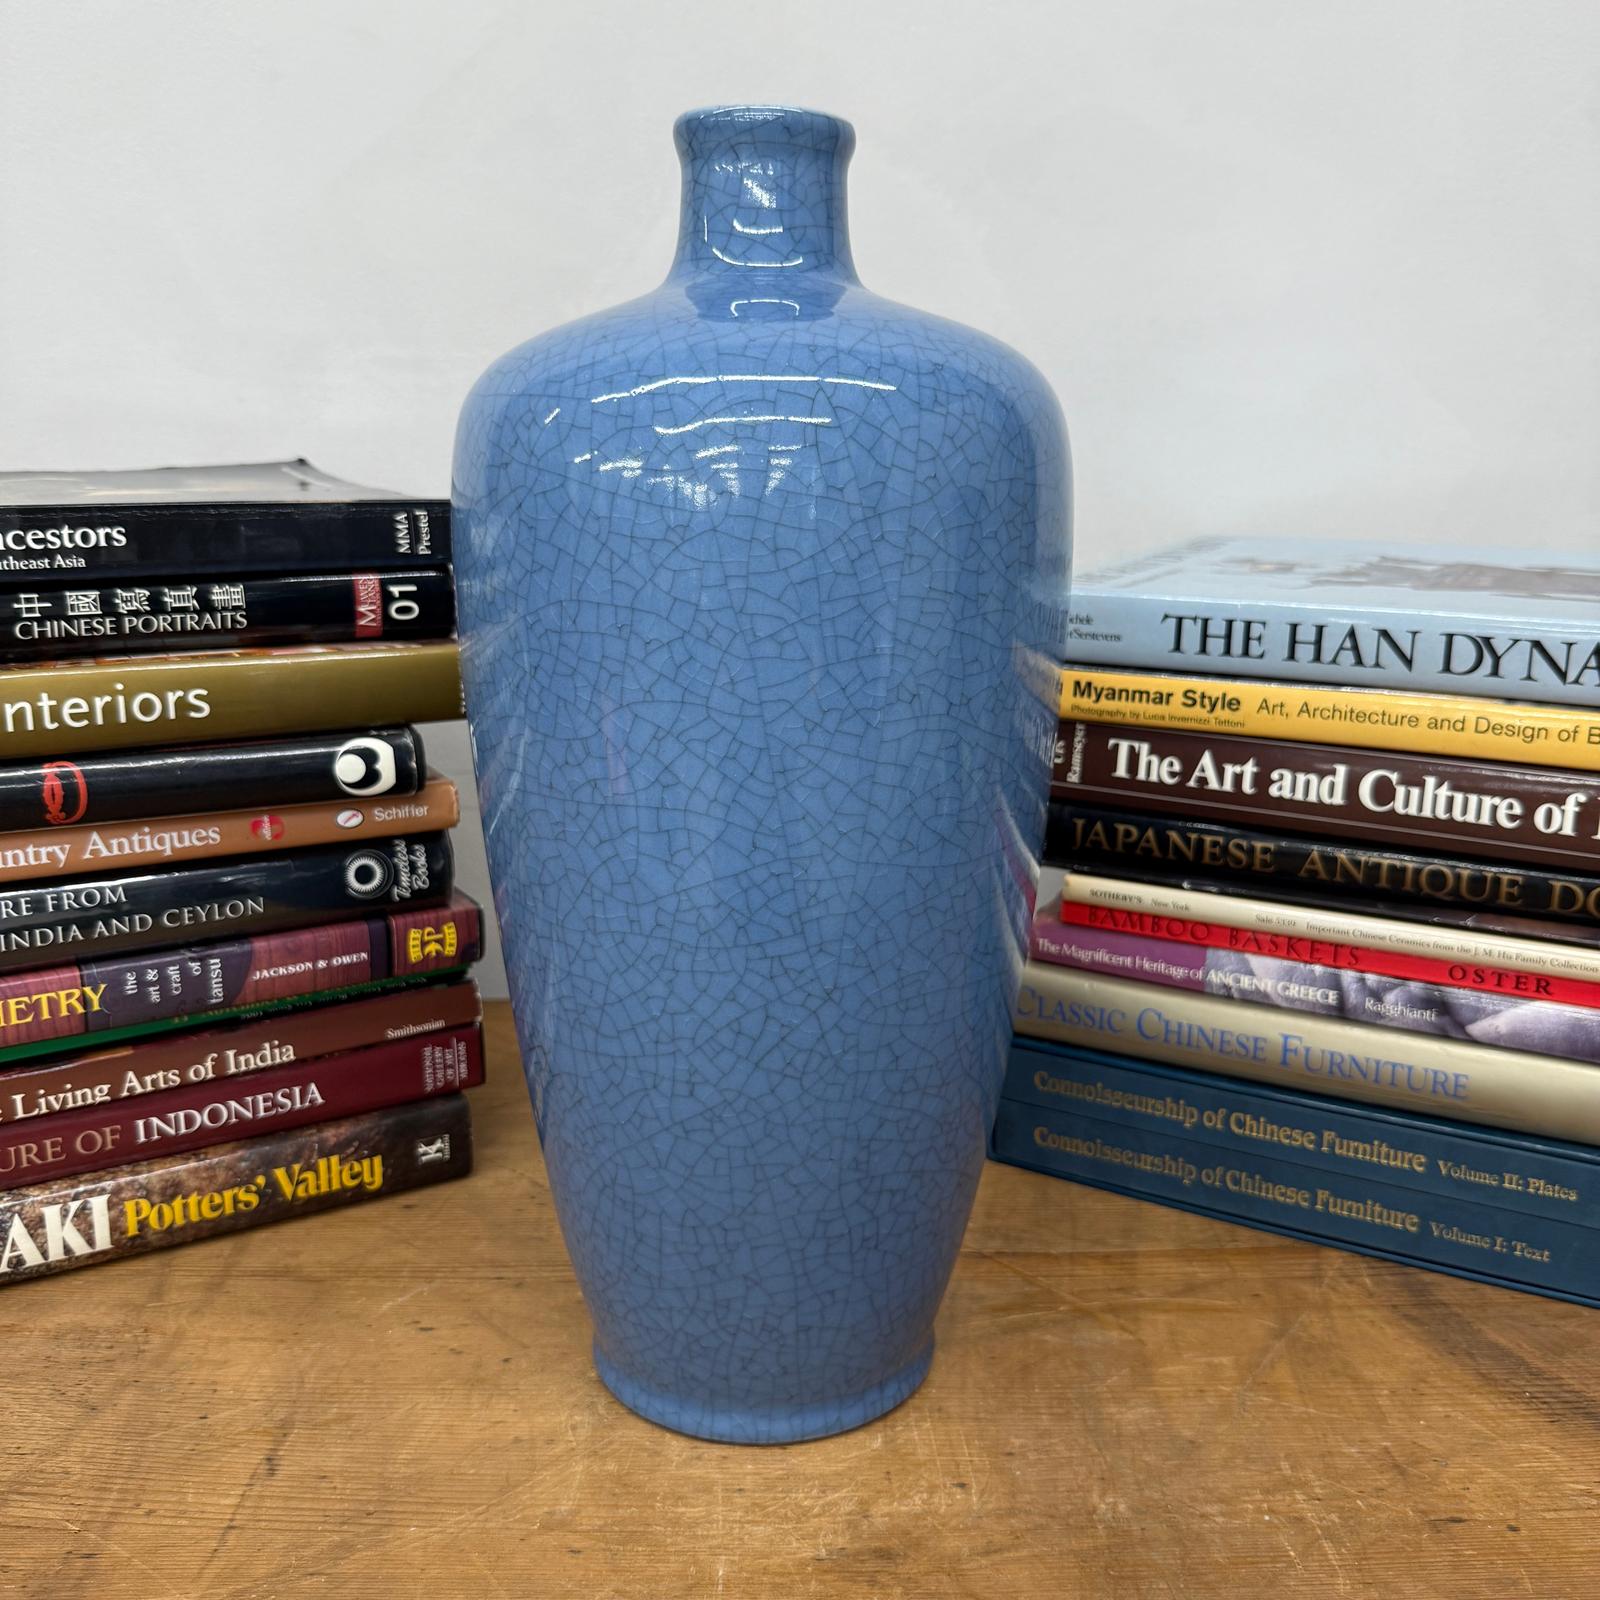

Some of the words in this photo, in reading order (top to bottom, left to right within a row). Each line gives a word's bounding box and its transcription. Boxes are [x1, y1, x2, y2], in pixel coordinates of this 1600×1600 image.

[393, 511, 411, 553] MMA
[415, 509, 431, 554] Prestel
[53, 553, 87, 568] Asia
[387, 584, 420, 620] 01
[14, 617, 118, 640] CHINESE
[124, 611, 248, 635] PORTRAITS
[1161, 613, 1267, 660] THE
[1283, 622, 1422, 673] HAN
[1437, 633, 1600, 687] DYNA
[3, 682, 211, 733] nteriors
[1070, 704, 1127, 719] Photography
[1129, 711, 1140, 719] by
[1143, 711, 1165, 721] Luca
[1072, 680, 1173, 706] Myanmar
[1181, 689, 1241, 714] Style
[1256, 698, 1290, 718] Art,
[1296, 701, 1418, 728] Architecture
[1426, 716, 1466, 732] and
[1474, 717, 1549, 743] Design
[1557, 725, 1579, 743] of
[1107, 738, 1183, 785] The
[1186, 749, 1260, 795] Art
[1268, 764, 1349, 806] and
[1358, 769, 1524, 830] Culture
[1533, 793, 1587, 836] of
[374, 804, 430, 822] Schiffer
[83, 827, 222, 859] Antiques
[1072, 818, 1276, 872] JAPANESE
[1298, 849, 1524, 906] ANTIQUE
[0, 897, 33, 919] RE
[46, 887, 128, 913] FROM
[0, 924, 84, 952] INDIA
[94, 913, 153, 938] AND
[162, 897, 265, 928] CEYLON
[1087, 903, 1210, 941] BAMBOO
[1228, 927, 1361, 965] BASKETS
[1448, 964, 1554, 996] OSTER
[1151, 898, 1169, 908] New
[1171, 900, 1190, 911] York
[1306, 922, 1350, 938] Important
[1352, 929, 1387, 942] Chinese
[1388, 935, 1430, 948] Ceramics
[1432, 941, 1455, 951] from
[1457, 944, 1471, 954] the
[1497, 952, 1513, 960] Hu
[1515, 954, 1547, 966] Family
[1550, 958, 1599, 974] Collection
[120, 970, 138, 995] the
[146, 968, 160, 981] &
[166, 964, 182, 996] craft
[188, 961, 201, 976] of
[208, 958, 224, 1004] tansu
[252, 962, 313, 981] JACKSON
[317, 959, 328, 968] &
[333, 952, 368, 967] OWEN
[1038, 938, 1059, 954] The
[1061, 943, 1132, 968] Magnificent
[1136, 956, 1189, 980] Heritage
[1190, 967, 1205, 981] of
[1206, 968, 1275, 993] ANCIENT
[1277, 982, 1340, 1005] GREECE
[147, 985, 161, 1004] art
[1364, 997, 1438, 1022] Ragghianti
[386, 1017, 446, 1040] Smithsonian
[1015, 985, 1125, 1033] CLASSIC
[1136, 1007, 1268, 1061] CHINESE
[1279, 1033, 1470, 1098] FURNITURE
[11, 1083, 112, 1120] Living
[119, 1069, 181, 1097] Arts
[185, 1053, 218, 1082] of
[225, 1039, 297, 1077] India
[0, 1137, 66, 1172] URE
[75, 1124, 121, 1154] OF
[134, 1081, 326, 1144] INDONESIA
[1033, 1070, 1198, 1129] Connoisseurship
[1202, 1108, 1227, 1129] of
[1229, 1112, 1317, 1150] Chinese
[1320, 1130, 1427, 1173] Furniture
[1437, 1159, 1500, 1186] Volume
[1502, 1173, 1523, 1191] II:
[1527, 1177, 1579, 1201] Plates
[0, 1193, 114, 1273] AKI
[123, 1175, 266, 1238] Potters'
[272, 1153, 384, 1200] Valley
[1033, 1126, 1196, 1185] Connoisseurship
[1201, 1166, 1224, 1186] of
[1225, 1169, 1311, 1207] Chinese
[1314, 1188, 1420, 1233] Furniture
[1428, 1220, 1490, 1249] Volume
[1511, 1240, 1552, 1264] Text
